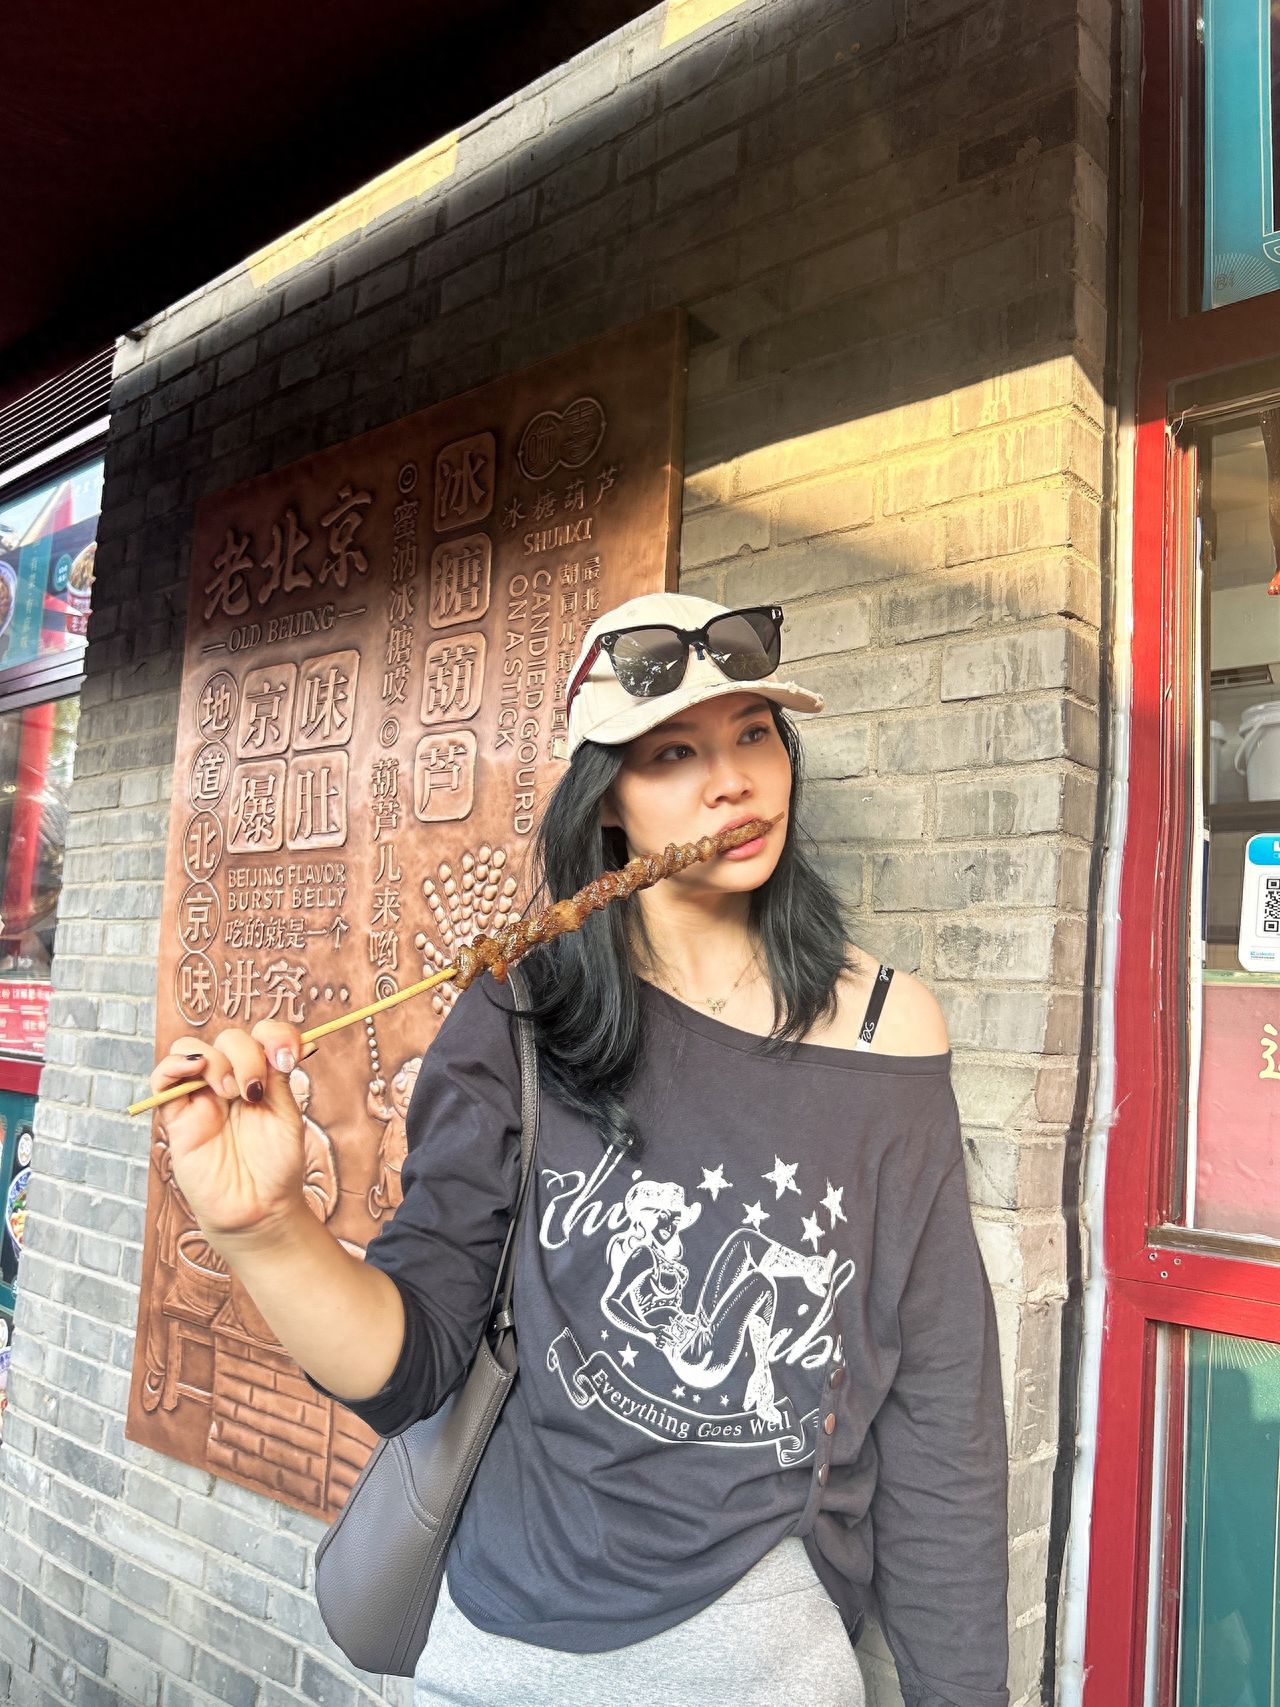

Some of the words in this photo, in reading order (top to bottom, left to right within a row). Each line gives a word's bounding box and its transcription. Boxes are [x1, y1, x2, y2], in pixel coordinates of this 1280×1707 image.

[502, 465, 620, 530] 冰糖葫芦
[203, 487, 372, 620] 老北京
[228, 624, 262, 652] OLD
[266, 603, 336, 644] BEIJING
[419, 449, 487, 814] 冰糖葫芦
[507, 574, 529, 622] ON
[506, 631, 525, 651] A
[526, 569, 552, 710] CANDIED
[495, 658, 524, 750] STICK
[513, 718, 541, 834] GOURD
[180, 682, 232, 1014] 地道北京味
[227, 865, 285, 889] BEIJING
[287, 862, 347, 886] FLAVOR
[224, 915, 350, 950] 吃的就是一个
[227, 889, 285, 911] BURST
[291, 887, 347, 909] BELLY
[591, 1368, 691, 1439] Everything
[697, 1421, 743, 1438] Goes
[749, 1410, 793, 1437] Well
